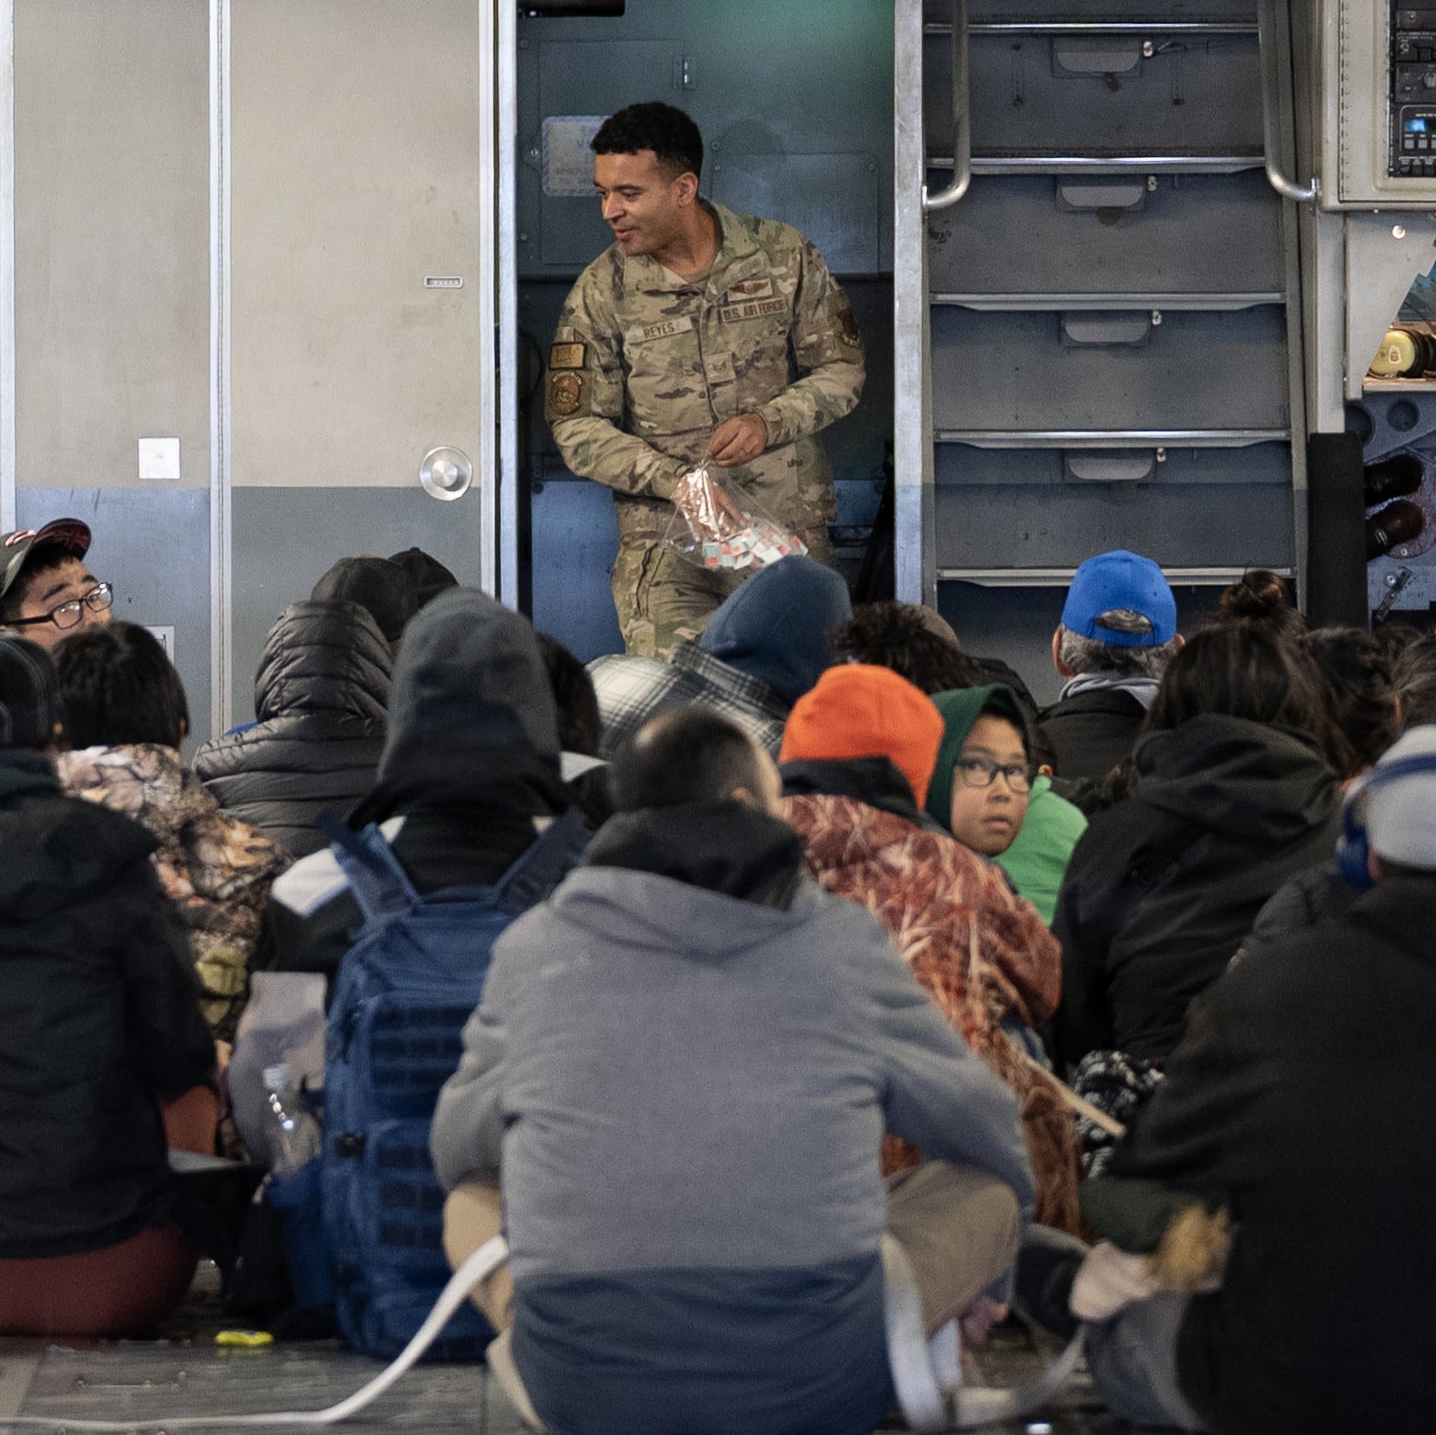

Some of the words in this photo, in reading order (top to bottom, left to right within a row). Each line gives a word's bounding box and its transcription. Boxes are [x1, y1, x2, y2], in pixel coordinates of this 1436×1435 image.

[723, 307, 740, 321] U.S.
[743, 304, 757, 318] AIR
[758, 300, 786, 316] FORCE
[643, 322, 675, 339] REYES
